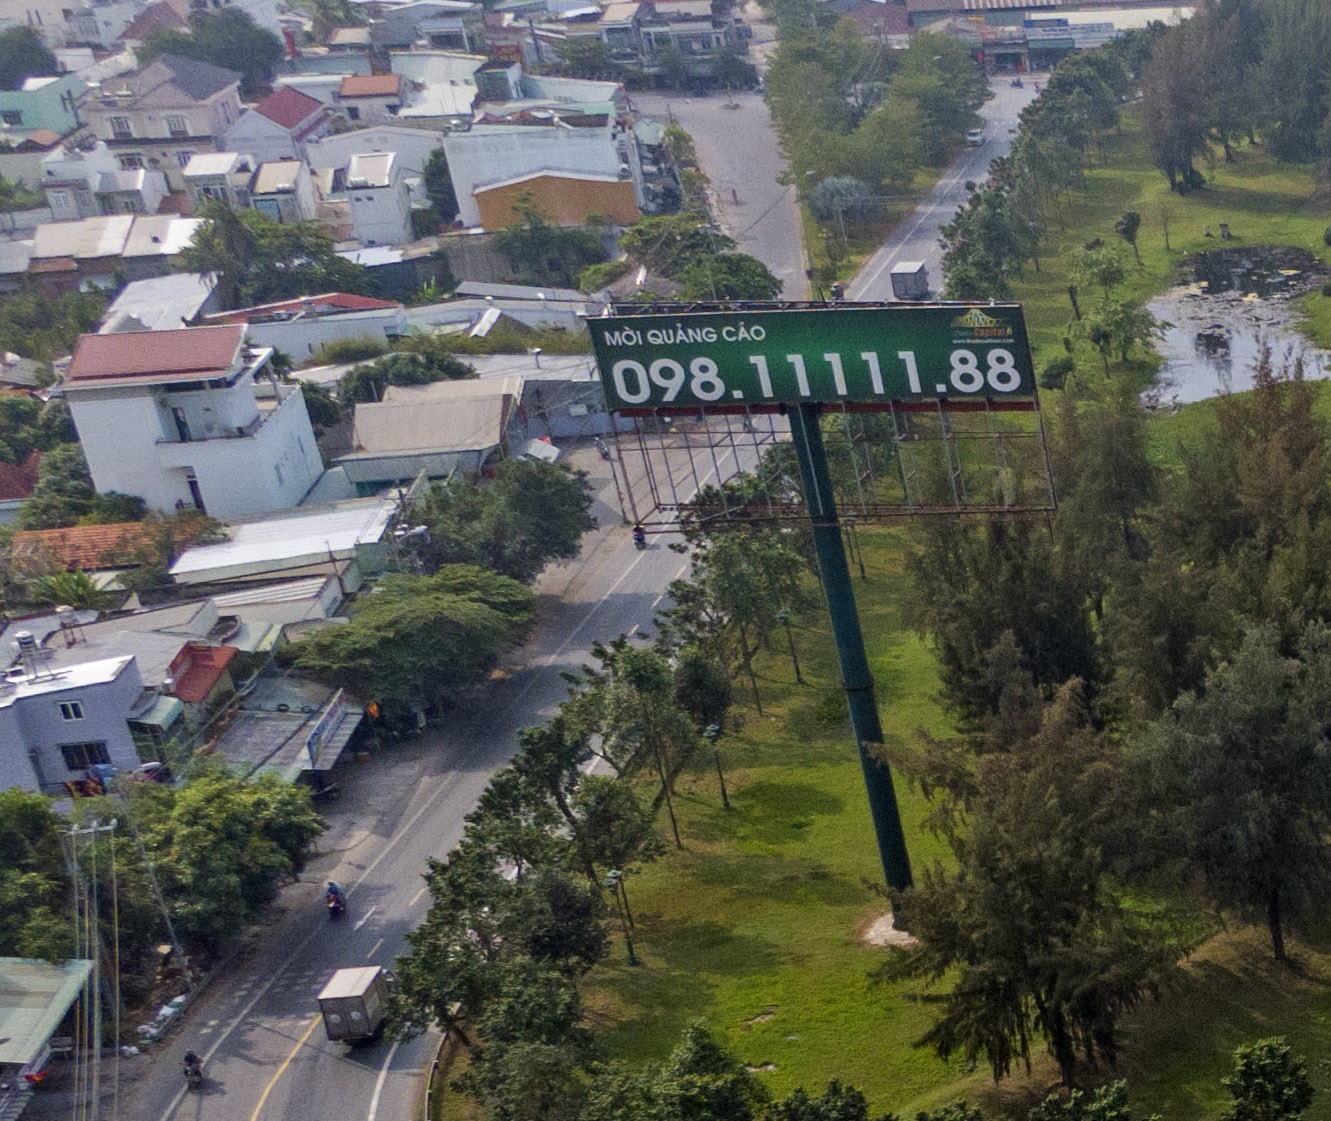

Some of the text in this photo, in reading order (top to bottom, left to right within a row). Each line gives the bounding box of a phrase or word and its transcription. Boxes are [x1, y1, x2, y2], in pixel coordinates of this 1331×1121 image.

[604, 326, 643, 346] MỜI
[647, 323, 718, 345] QUẢNG
[611, 349, 1022, 404] 098.11111.88
